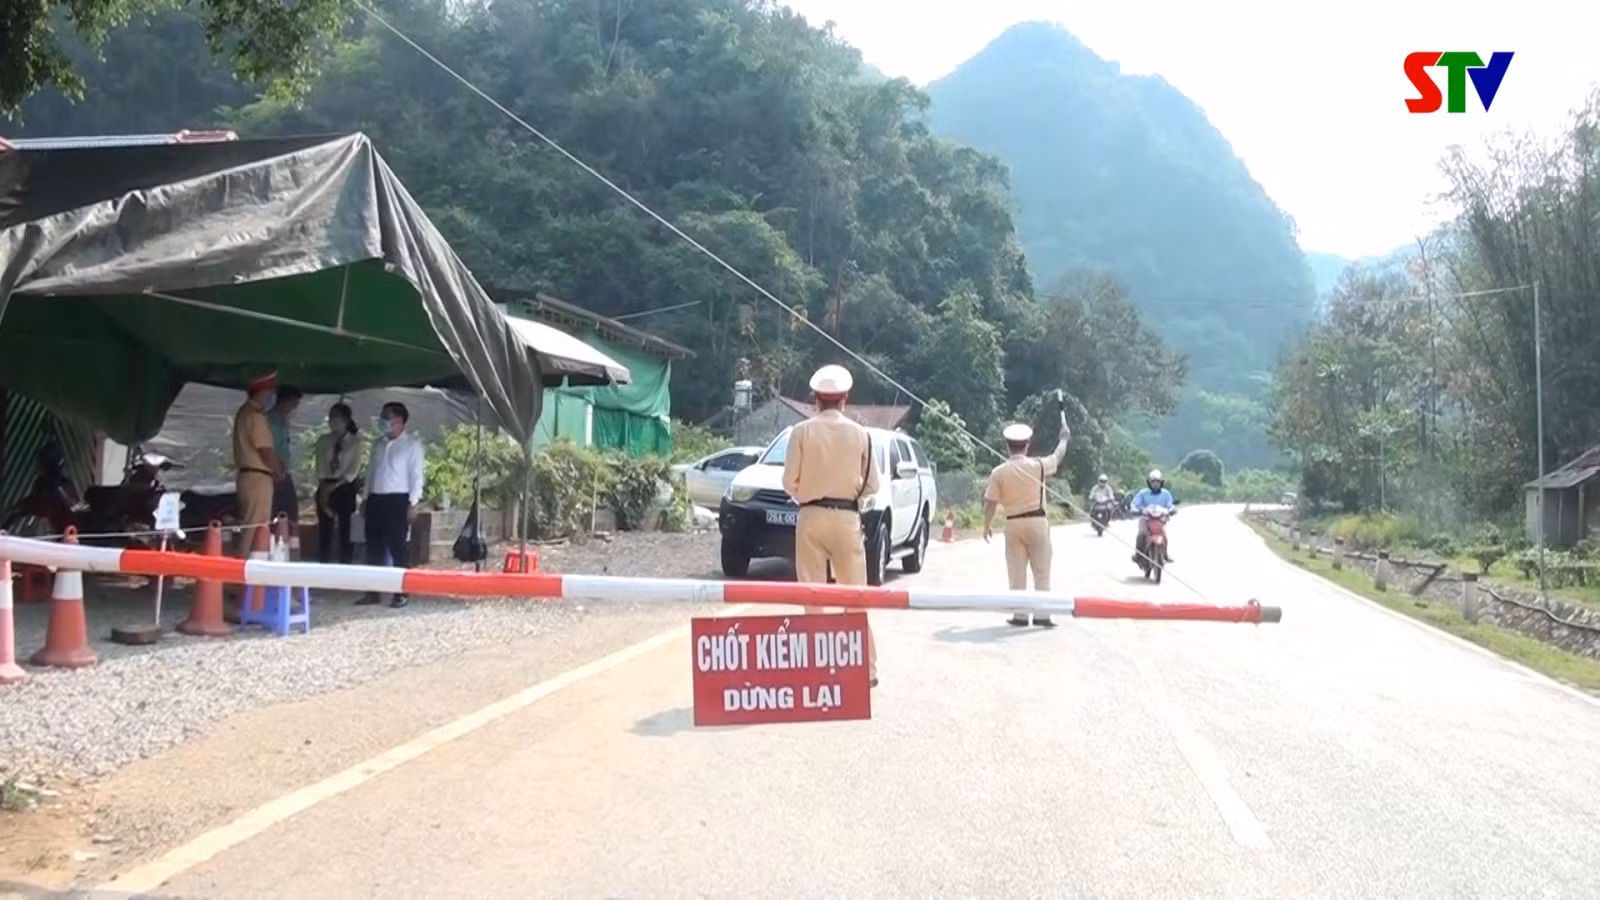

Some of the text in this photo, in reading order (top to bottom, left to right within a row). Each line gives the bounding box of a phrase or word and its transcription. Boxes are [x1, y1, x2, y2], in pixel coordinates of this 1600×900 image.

[697, 618, 863, 674] CHỐT KIỂM DỊCH
[723, 682, 841, 712] DỪNG LẠI
